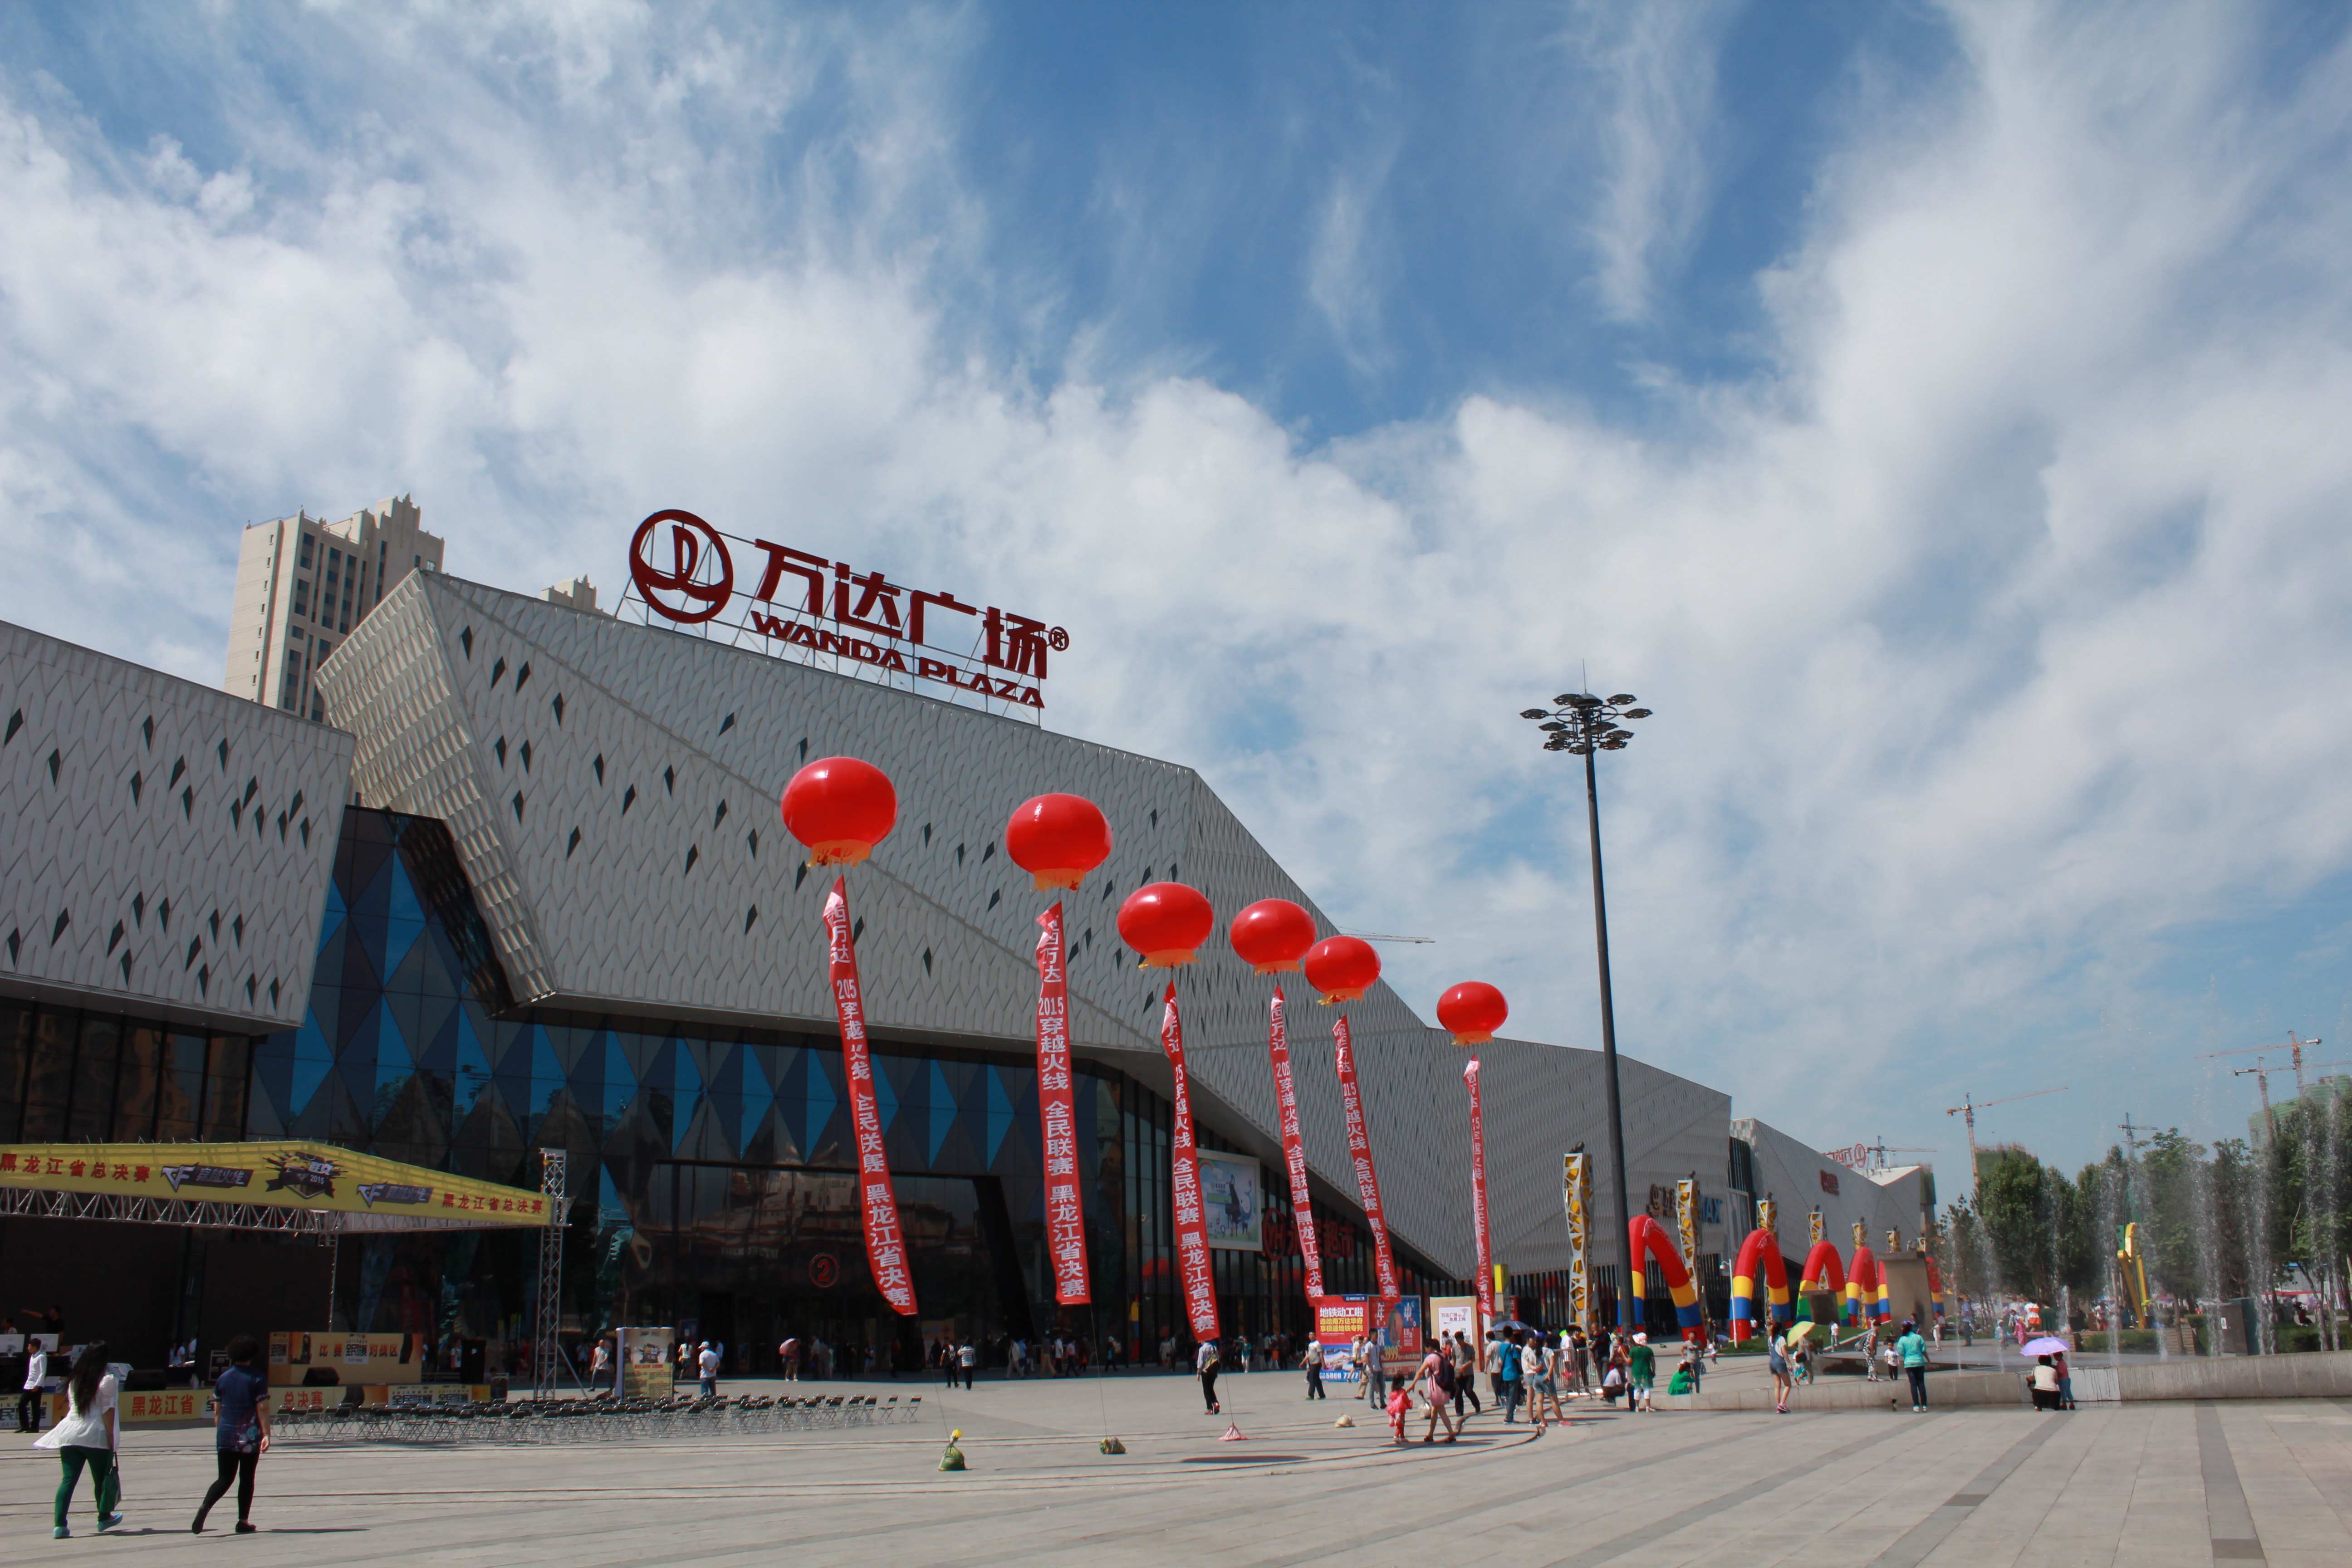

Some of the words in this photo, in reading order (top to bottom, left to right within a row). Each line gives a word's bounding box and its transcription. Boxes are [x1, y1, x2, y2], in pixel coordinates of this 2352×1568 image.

[755, 538, 1047, 679] 万达广场
[750, 610, 907, 672] WANDA
[918, 657, 1045, 709] PLAZA
[0, 1153, 151, 1183] 黑龙江省总决赛
[1044, 1100, 1074, 1176] 全民联赛
[310, 1175, 325, 1185] 2015
[442, 1193, 543, 1214] 黑龙江省总决赛
[1173, 1157, 1200, 1225] 全民联赛
[1287, 1144, 1310, 1205] 全民联赛
[1354, 1157, 1378, 1211] 全民联赛
[866, 1183, 911, 1307] 黑龙江省决赛
[1049, 1184, 1086, 1297] 黑龙江省决赛
[1180, 1231, 1215, 1333] 黑龙江省决赛
[1319, 1307, 1364, 1318] 地铁动工啦
[131, 1394, 194, 1416] 黑龙江省
